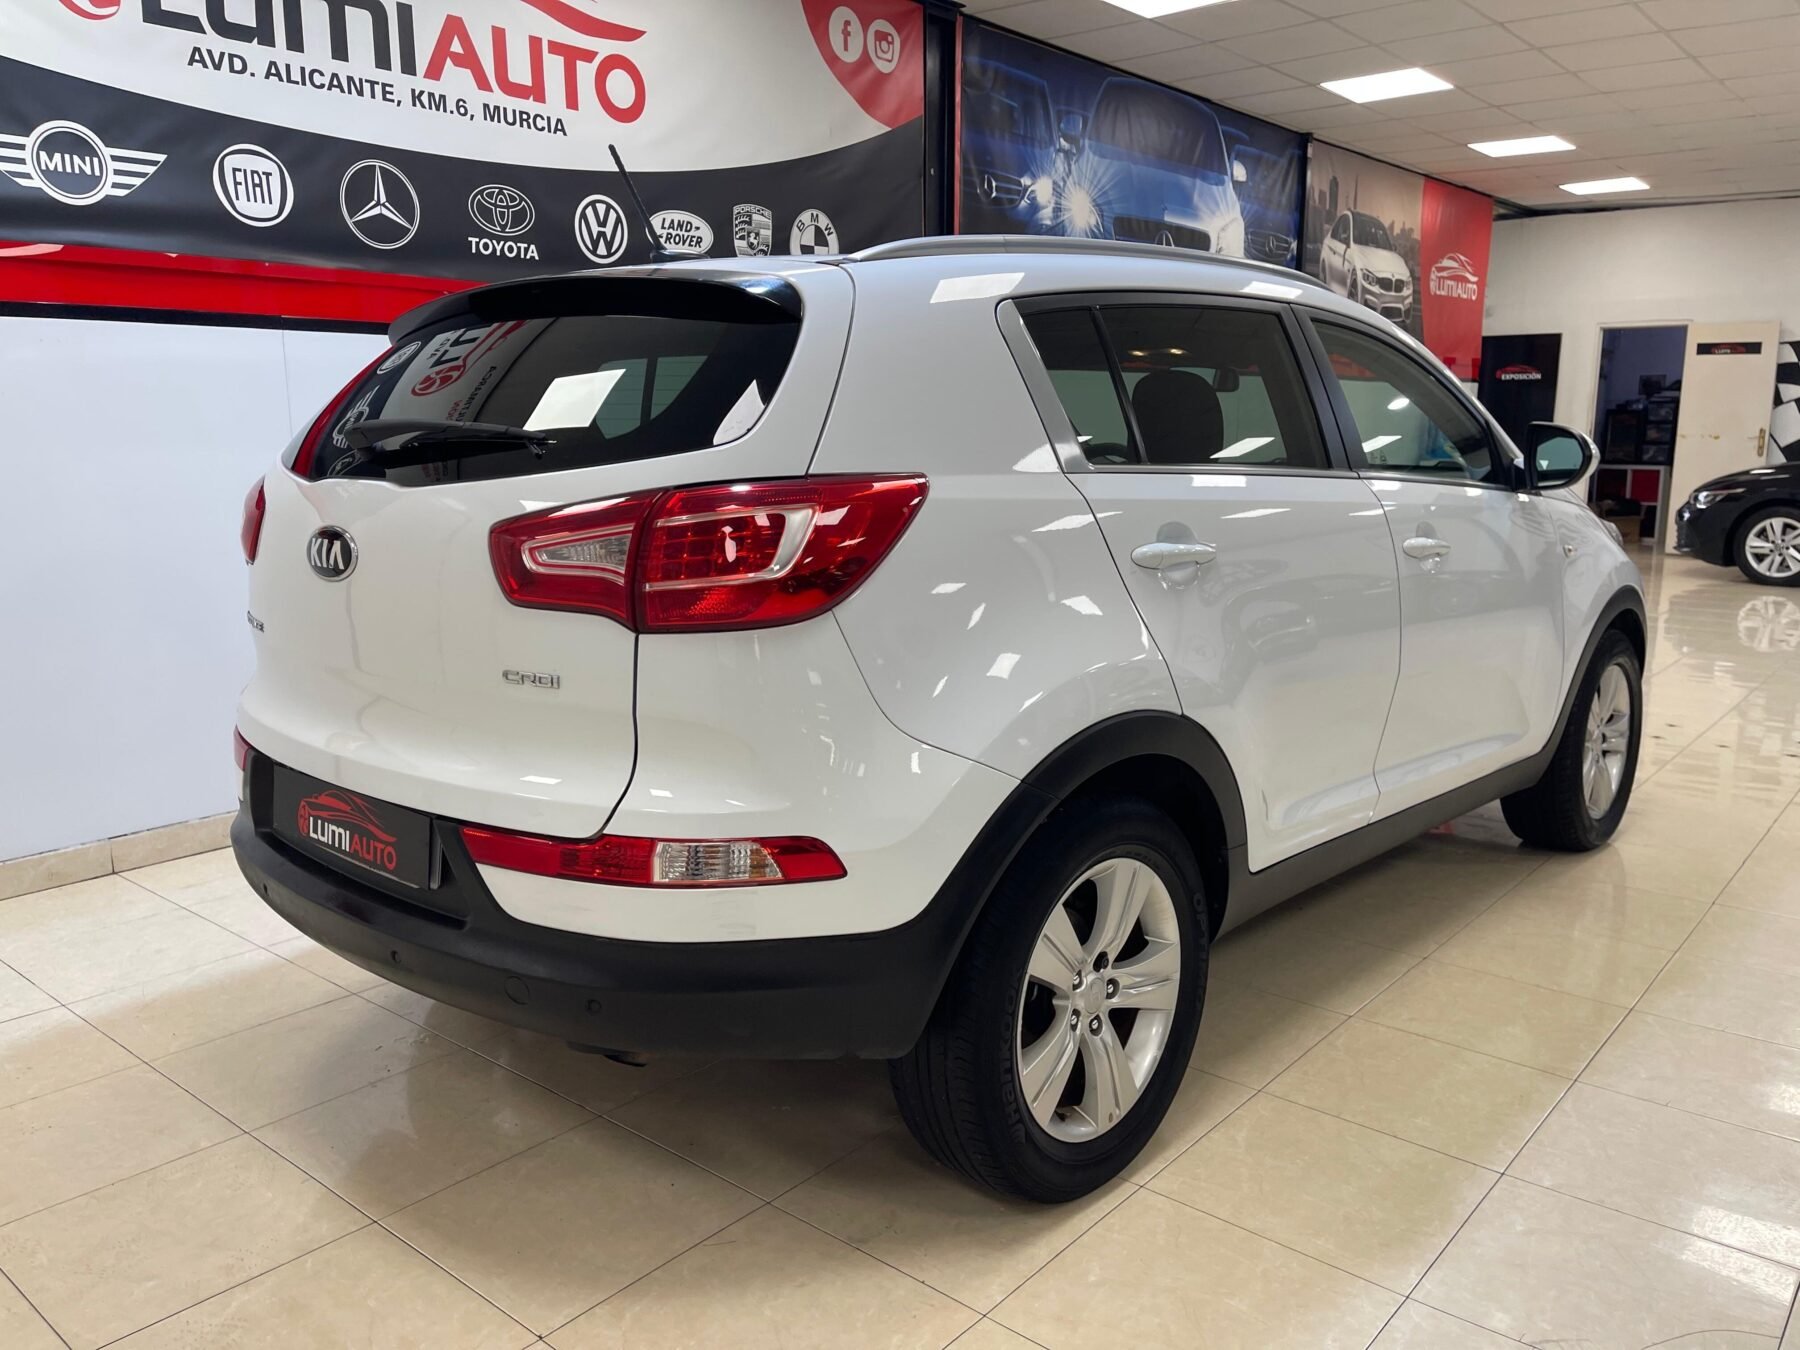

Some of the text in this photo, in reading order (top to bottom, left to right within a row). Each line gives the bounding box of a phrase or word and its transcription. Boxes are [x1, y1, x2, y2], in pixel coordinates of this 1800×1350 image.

[187, 46, 568, 136] AVD. ALICANTE, KM.6, MURCIA
[39, 150, 101, 177] MINI
[231, 167, 273, 205] FIAT
[660, 217, 693, 233] LAND
[734, 206, 771, 220] PORSCHE
[796, 212, 834, 236] BMW
[467, 236, 539, 260] TOYOTA
[663, 232, 703, 249] ROVER
[311, 537, 345, 570] KIA
